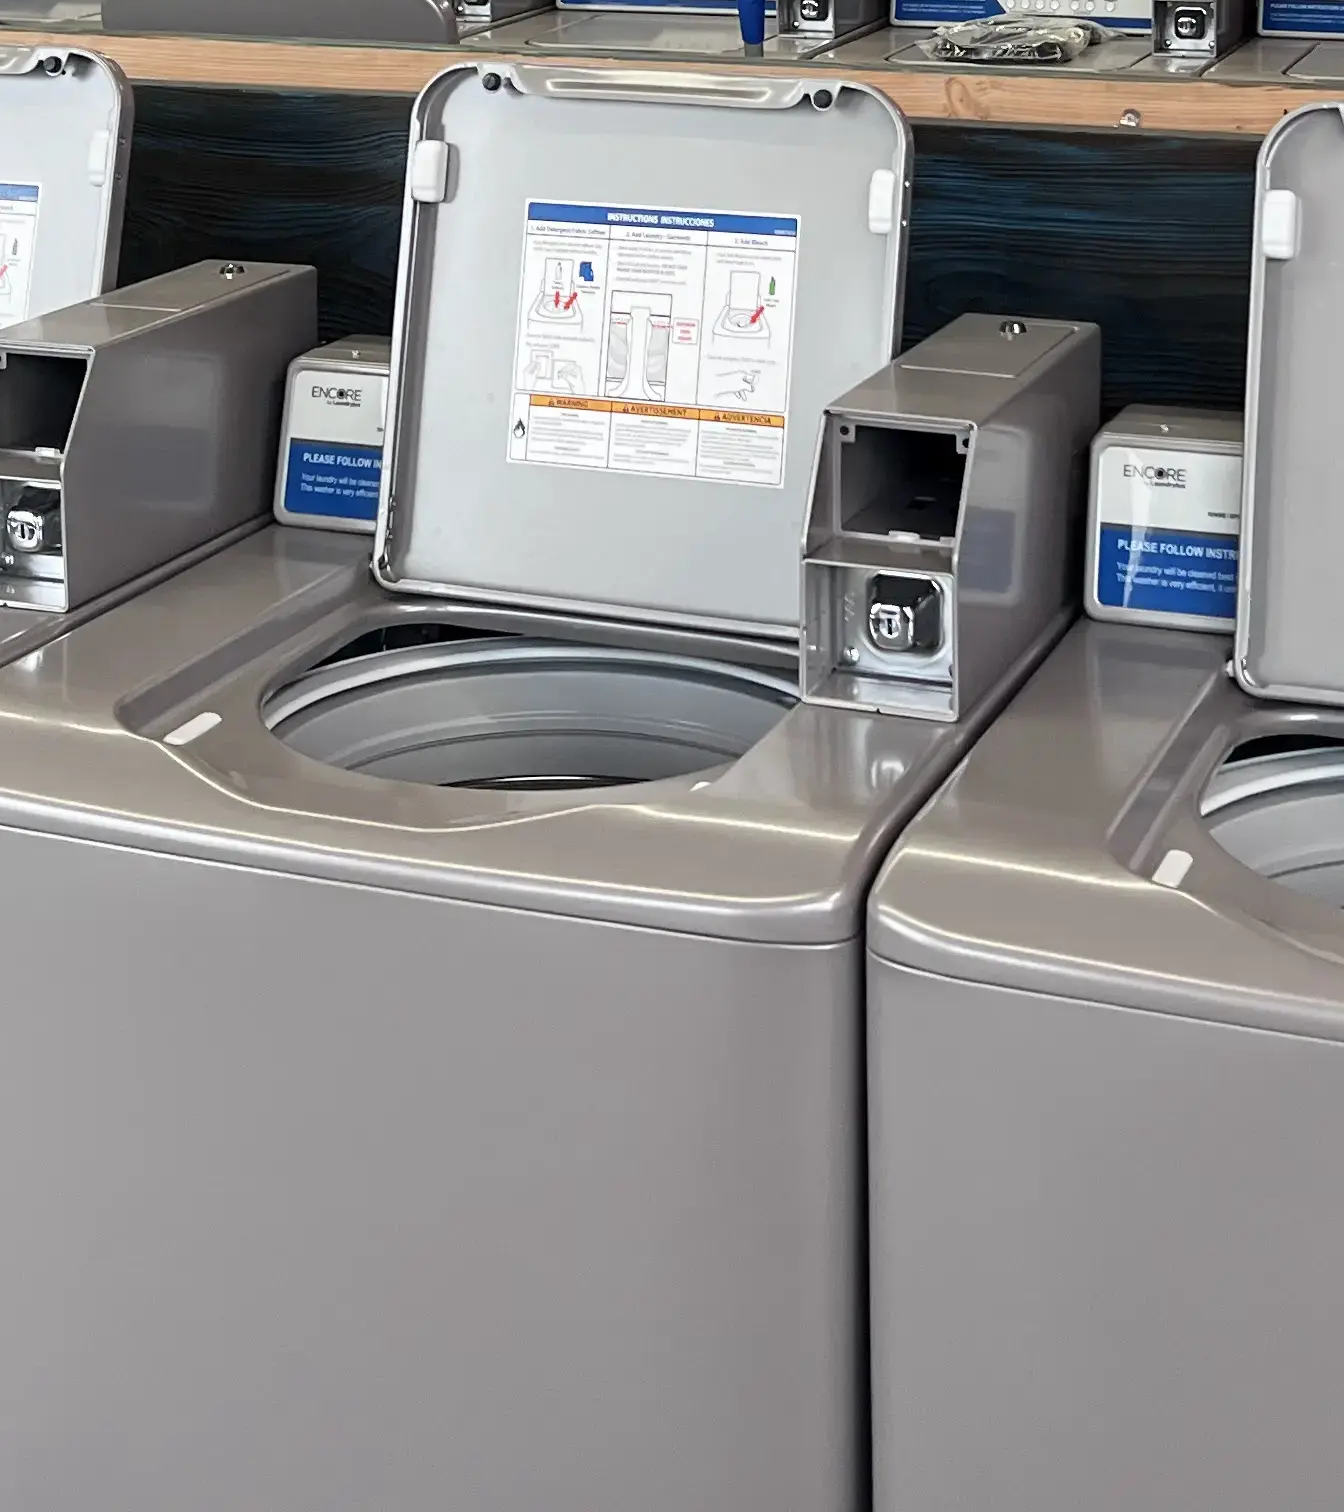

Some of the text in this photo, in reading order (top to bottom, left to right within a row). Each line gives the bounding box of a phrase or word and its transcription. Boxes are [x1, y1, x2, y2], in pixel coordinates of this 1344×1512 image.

[607, 212, 658, 225] INSTRUCTIONS
[311, 386, 363, 401] ENCORE
[556, 400, 772, 425] WARNING AVERTISSEMENT ADVERTENCIA
[303, 452, 336, 465] PLEASE
[336, 455, 372, 468] FOLLOW
[1123, 464, 1187, 482] ENCORE
[1117, 538, 1238, 560] PLEASE FOLLOW INSTR
